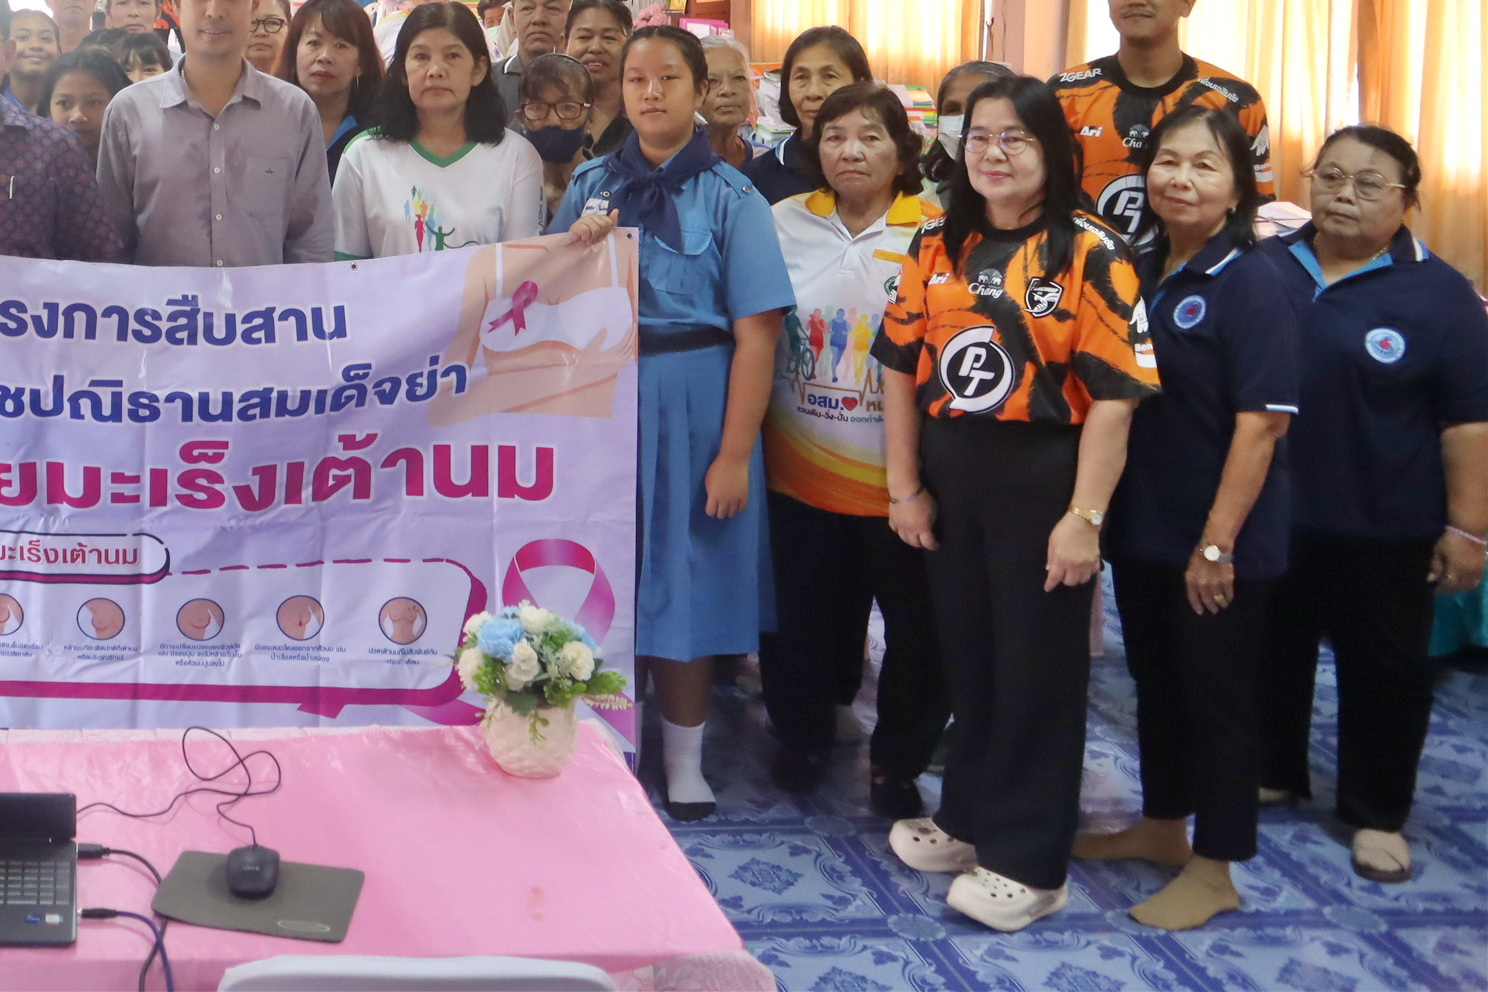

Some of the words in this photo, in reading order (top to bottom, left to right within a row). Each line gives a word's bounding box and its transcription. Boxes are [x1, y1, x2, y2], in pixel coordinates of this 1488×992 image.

[1080, 125, 1104, 137] Ari
[1122, 137, 1148, 149] Cha
[928, 273, 951, 285] Ari
[967, 282, 1004, 299] Chang
[807, 392, 845, 411] อสม.
